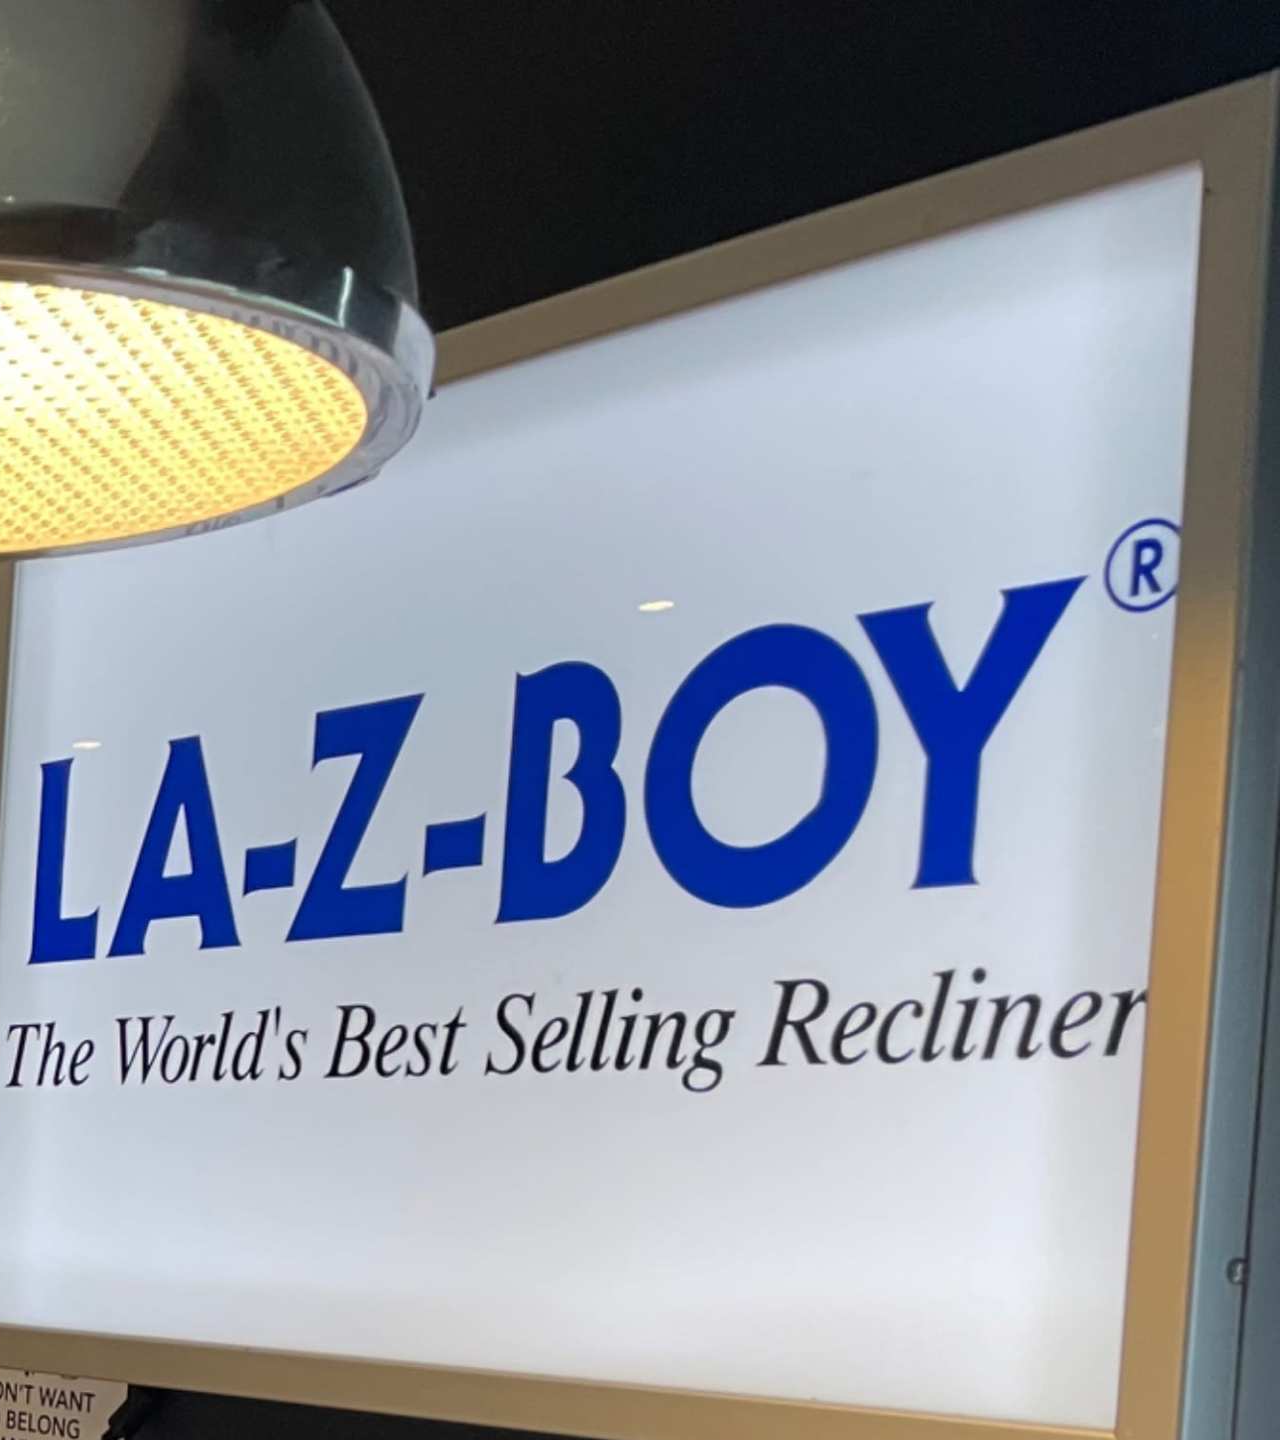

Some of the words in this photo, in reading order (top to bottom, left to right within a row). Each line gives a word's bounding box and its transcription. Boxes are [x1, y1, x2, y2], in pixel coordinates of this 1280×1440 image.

[28, 574, 1088, 966] LA-Z-BOY
[5, 1021, 95, 1088] The
[115, 1006, 308, 1085] World's
[324, 1002, 467, 1080] Best
[484, 986, 736, 1093] Selling
[756, 966, 1148, 1067] Recliner
[6, 1409, 80, 1439] BELONG
[39, 1389, 95, 1413] WANT
